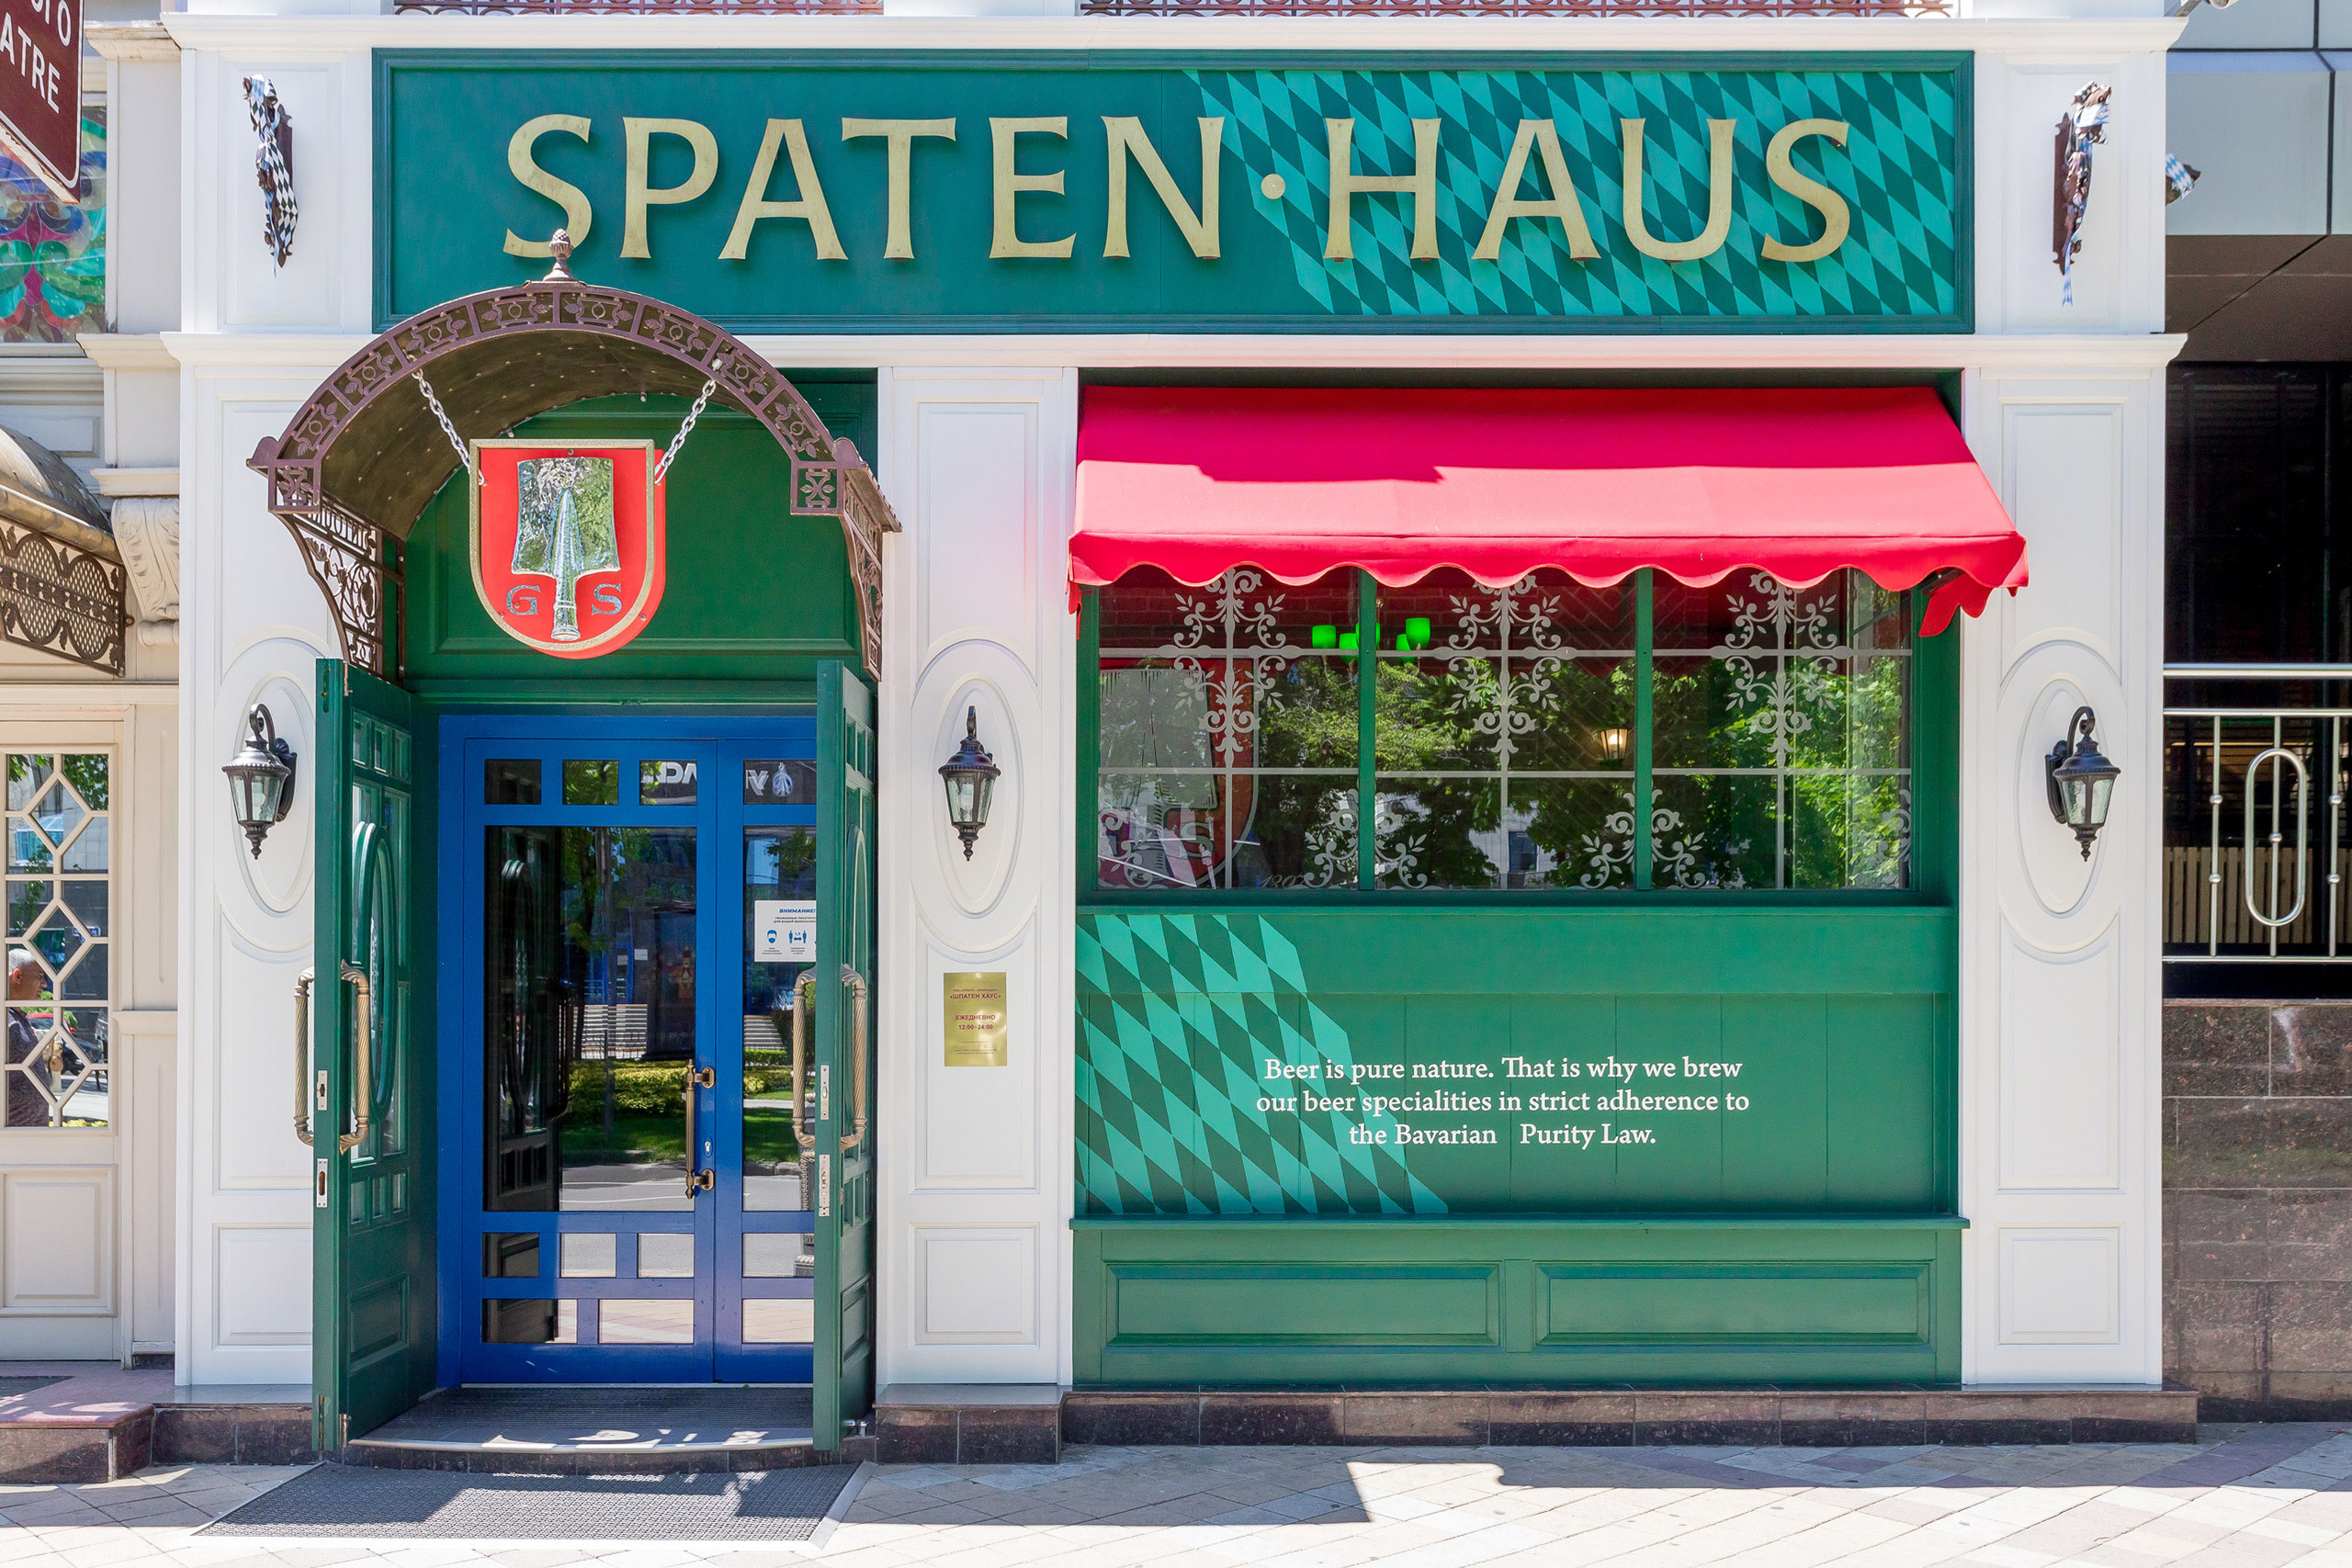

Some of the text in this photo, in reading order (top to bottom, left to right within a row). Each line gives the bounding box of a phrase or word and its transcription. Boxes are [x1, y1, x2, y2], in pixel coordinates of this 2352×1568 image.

[503, 113, 1850, 262] SPATEN HAUS
[505, 582, 624, 616] G S
[1263, 1055, 1744, 1086] Beer is pure nature. That is why we brew
[1256, 1089, 1750, 1117] our beer specialities in strict adherence to
[1349, 1122, 1657, 1151] the Bavarian Purity Law.
